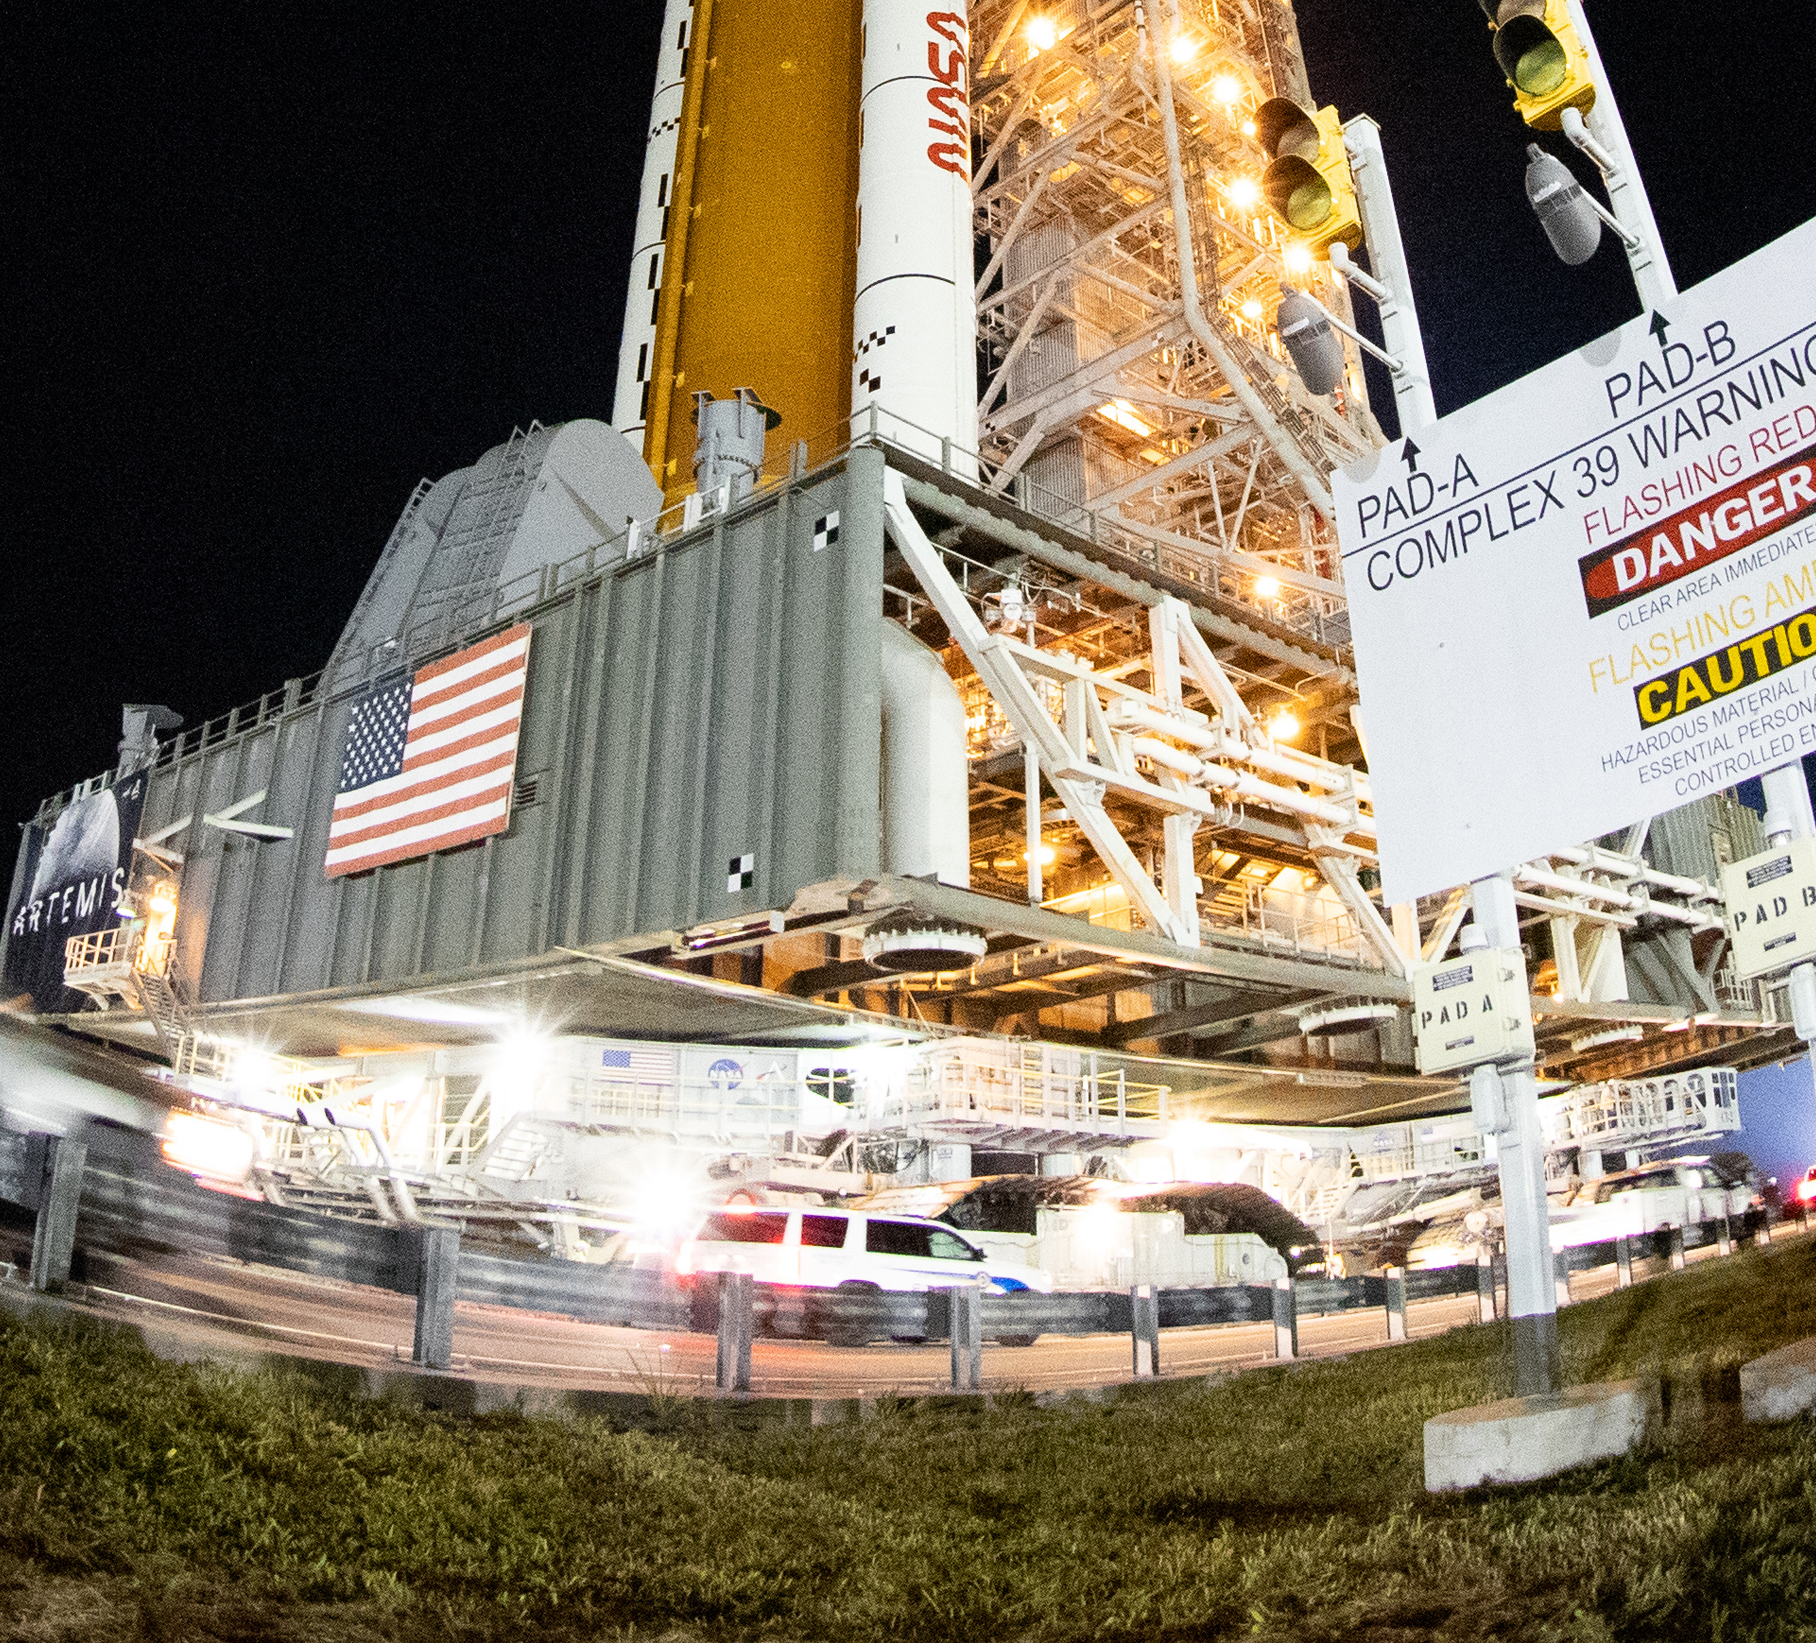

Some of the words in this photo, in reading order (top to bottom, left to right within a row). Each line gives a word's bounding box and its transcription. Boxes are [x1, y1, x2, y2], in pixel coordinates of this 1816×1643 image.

[926, 12, 970, 188] NASA
[1605, 320, 1736, 418] PAD-B
[1358, 453, 1479, 538] PAD-A
[1367, 470, 1565, 592] COMPLEX
[1572, 445, 1620, 498] 39
[1583, 444, 1743, 544] FLASHING
[1588, 594, 1756, 693] FLASHING
[1617, 595, 1672, 631] CLEAR
[1676, 572, 1723, 607] AREA
[1601, 717, 1709, 772] HAZARDOUS
[1713, 677, 1800, 727] MATERIAL
[1638, 739, 1735, 785] ESSENTIAL
[1675, 731, 1796, 796] CONTROLLED
[13, 867, 125, 936] ARTEMIS
[1734, 896, 1787, 931] PAD
[1802, 886, 1816, 907] B
[1421, 1001, 1468, 1029] PAD
[1483, 994, 1493, 1013] A
